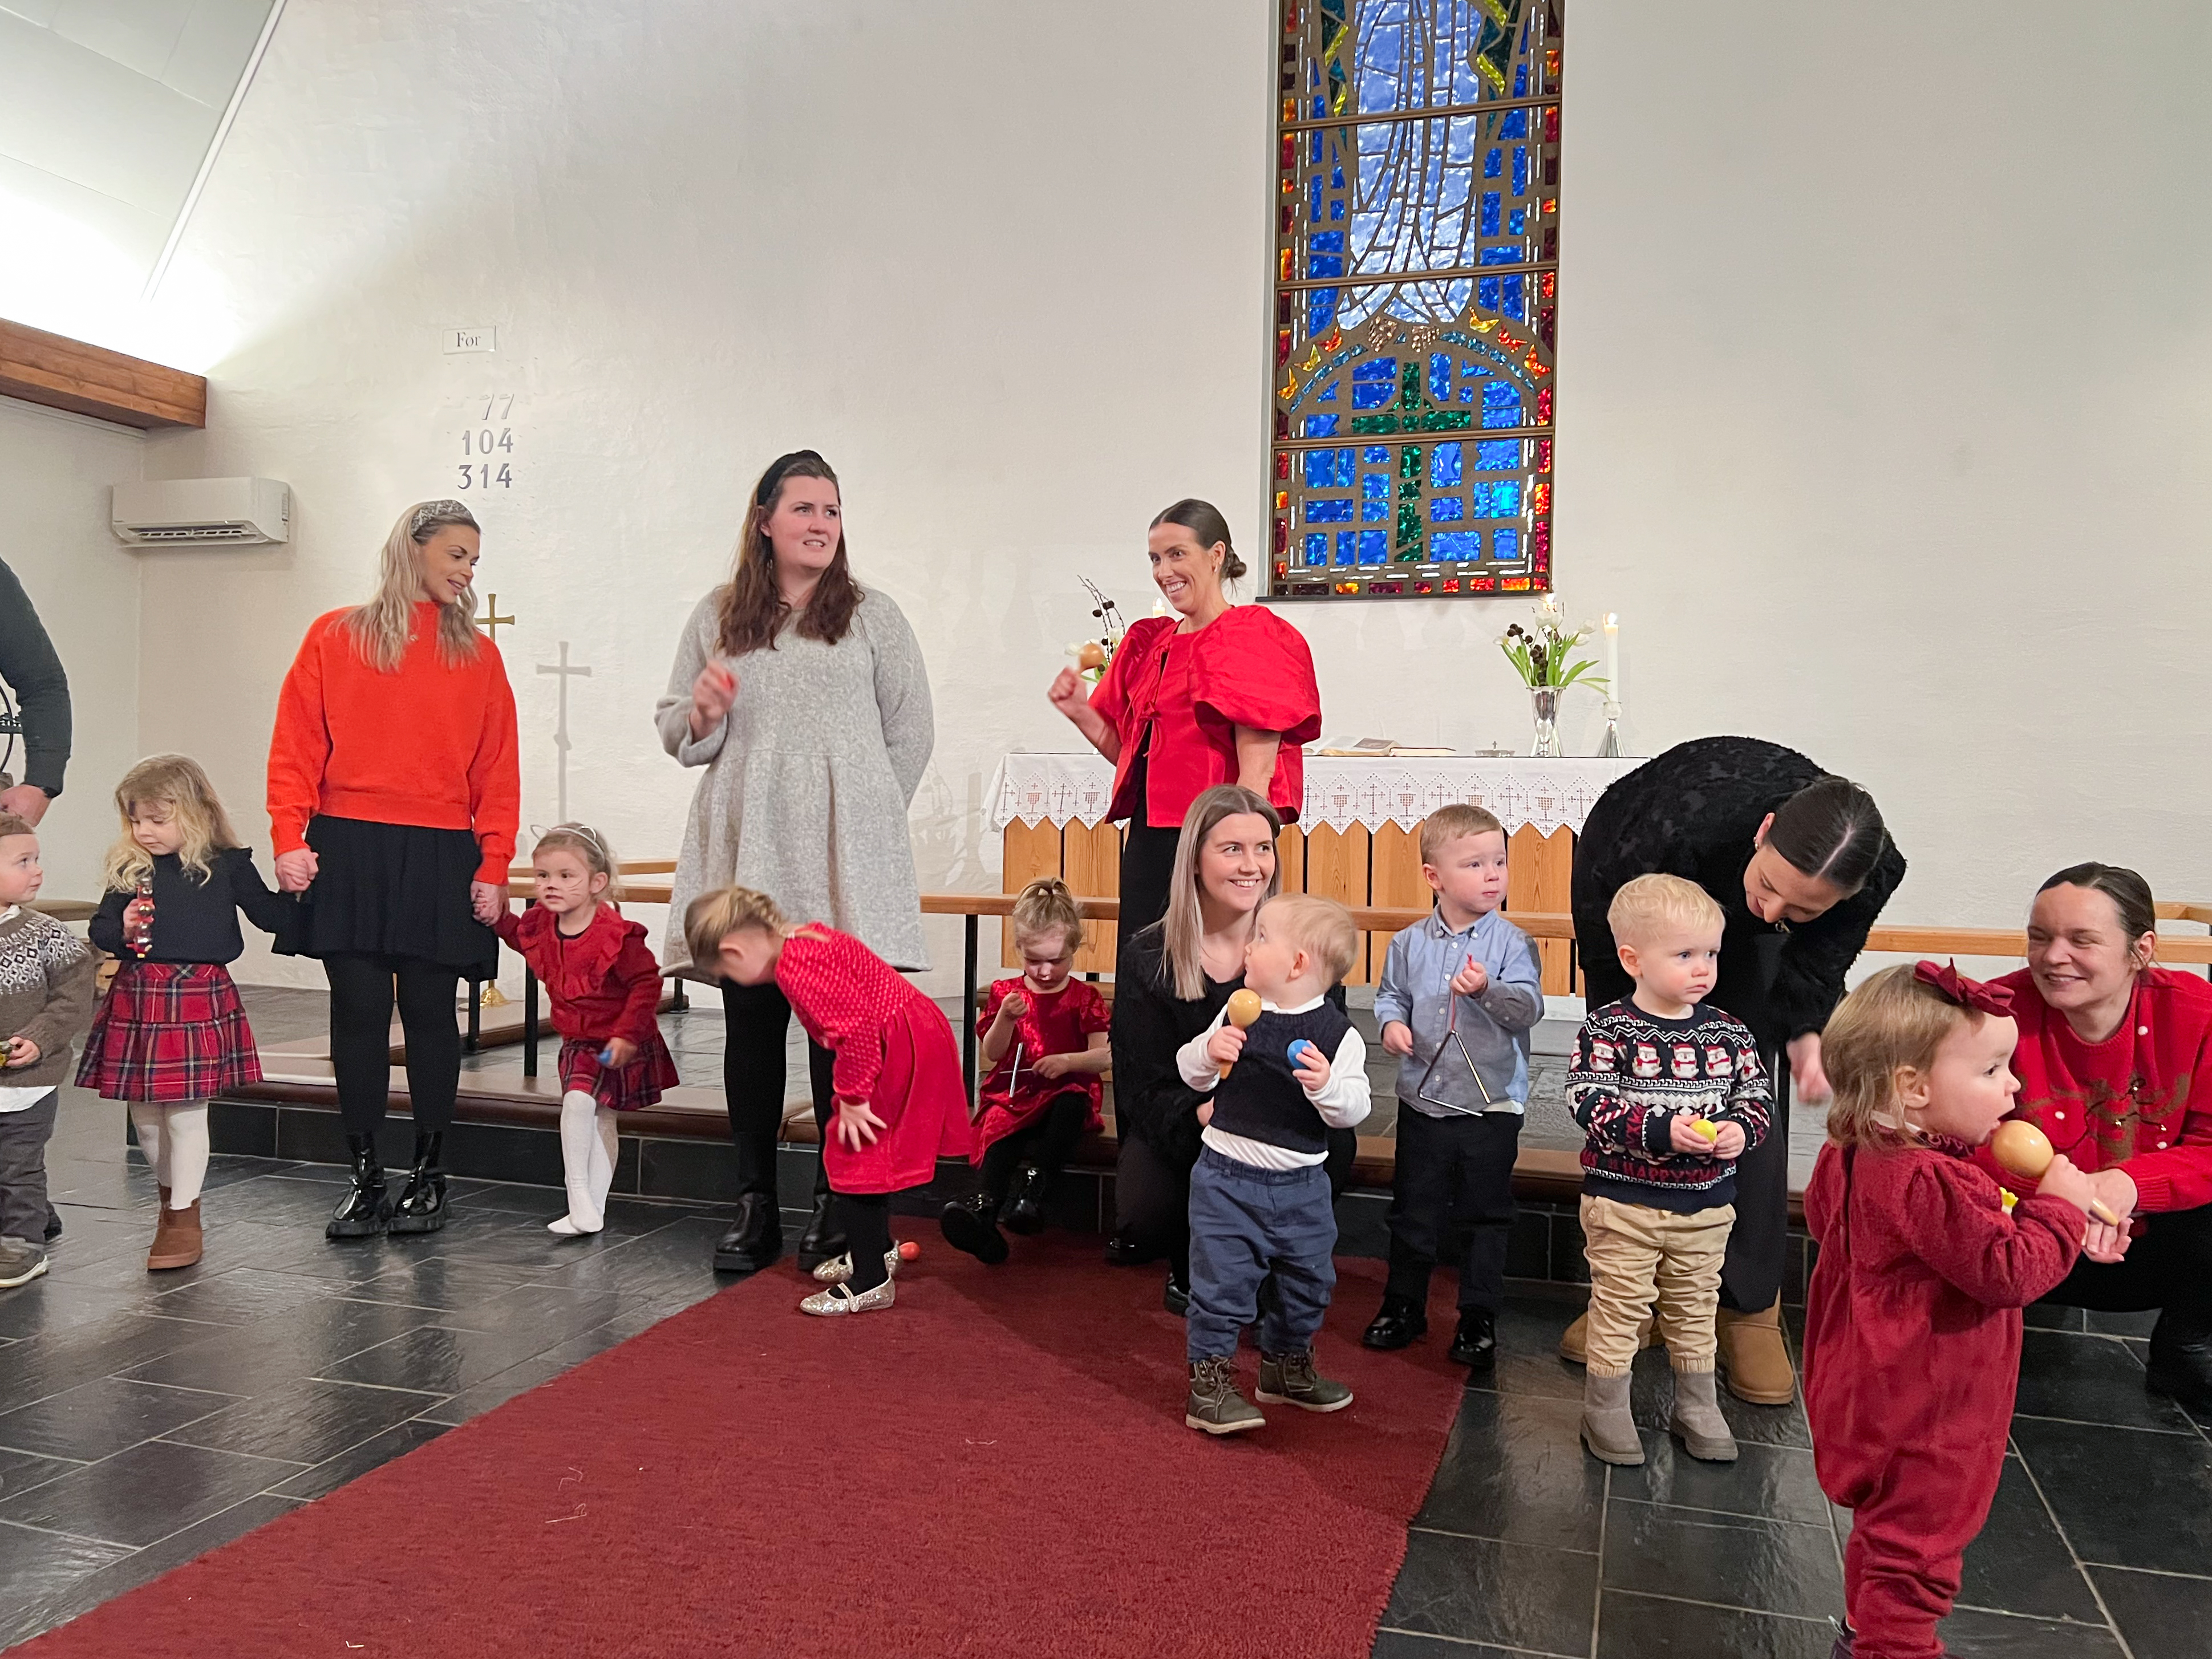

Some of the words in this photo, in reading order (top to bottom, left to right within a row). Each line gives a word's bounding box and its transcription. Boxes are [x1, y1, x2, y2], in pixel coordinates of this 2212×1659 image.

[479, 394, 514, 420] 77
[462, 428, 513, 456] 104
[457, 463, 512, 489] 314
